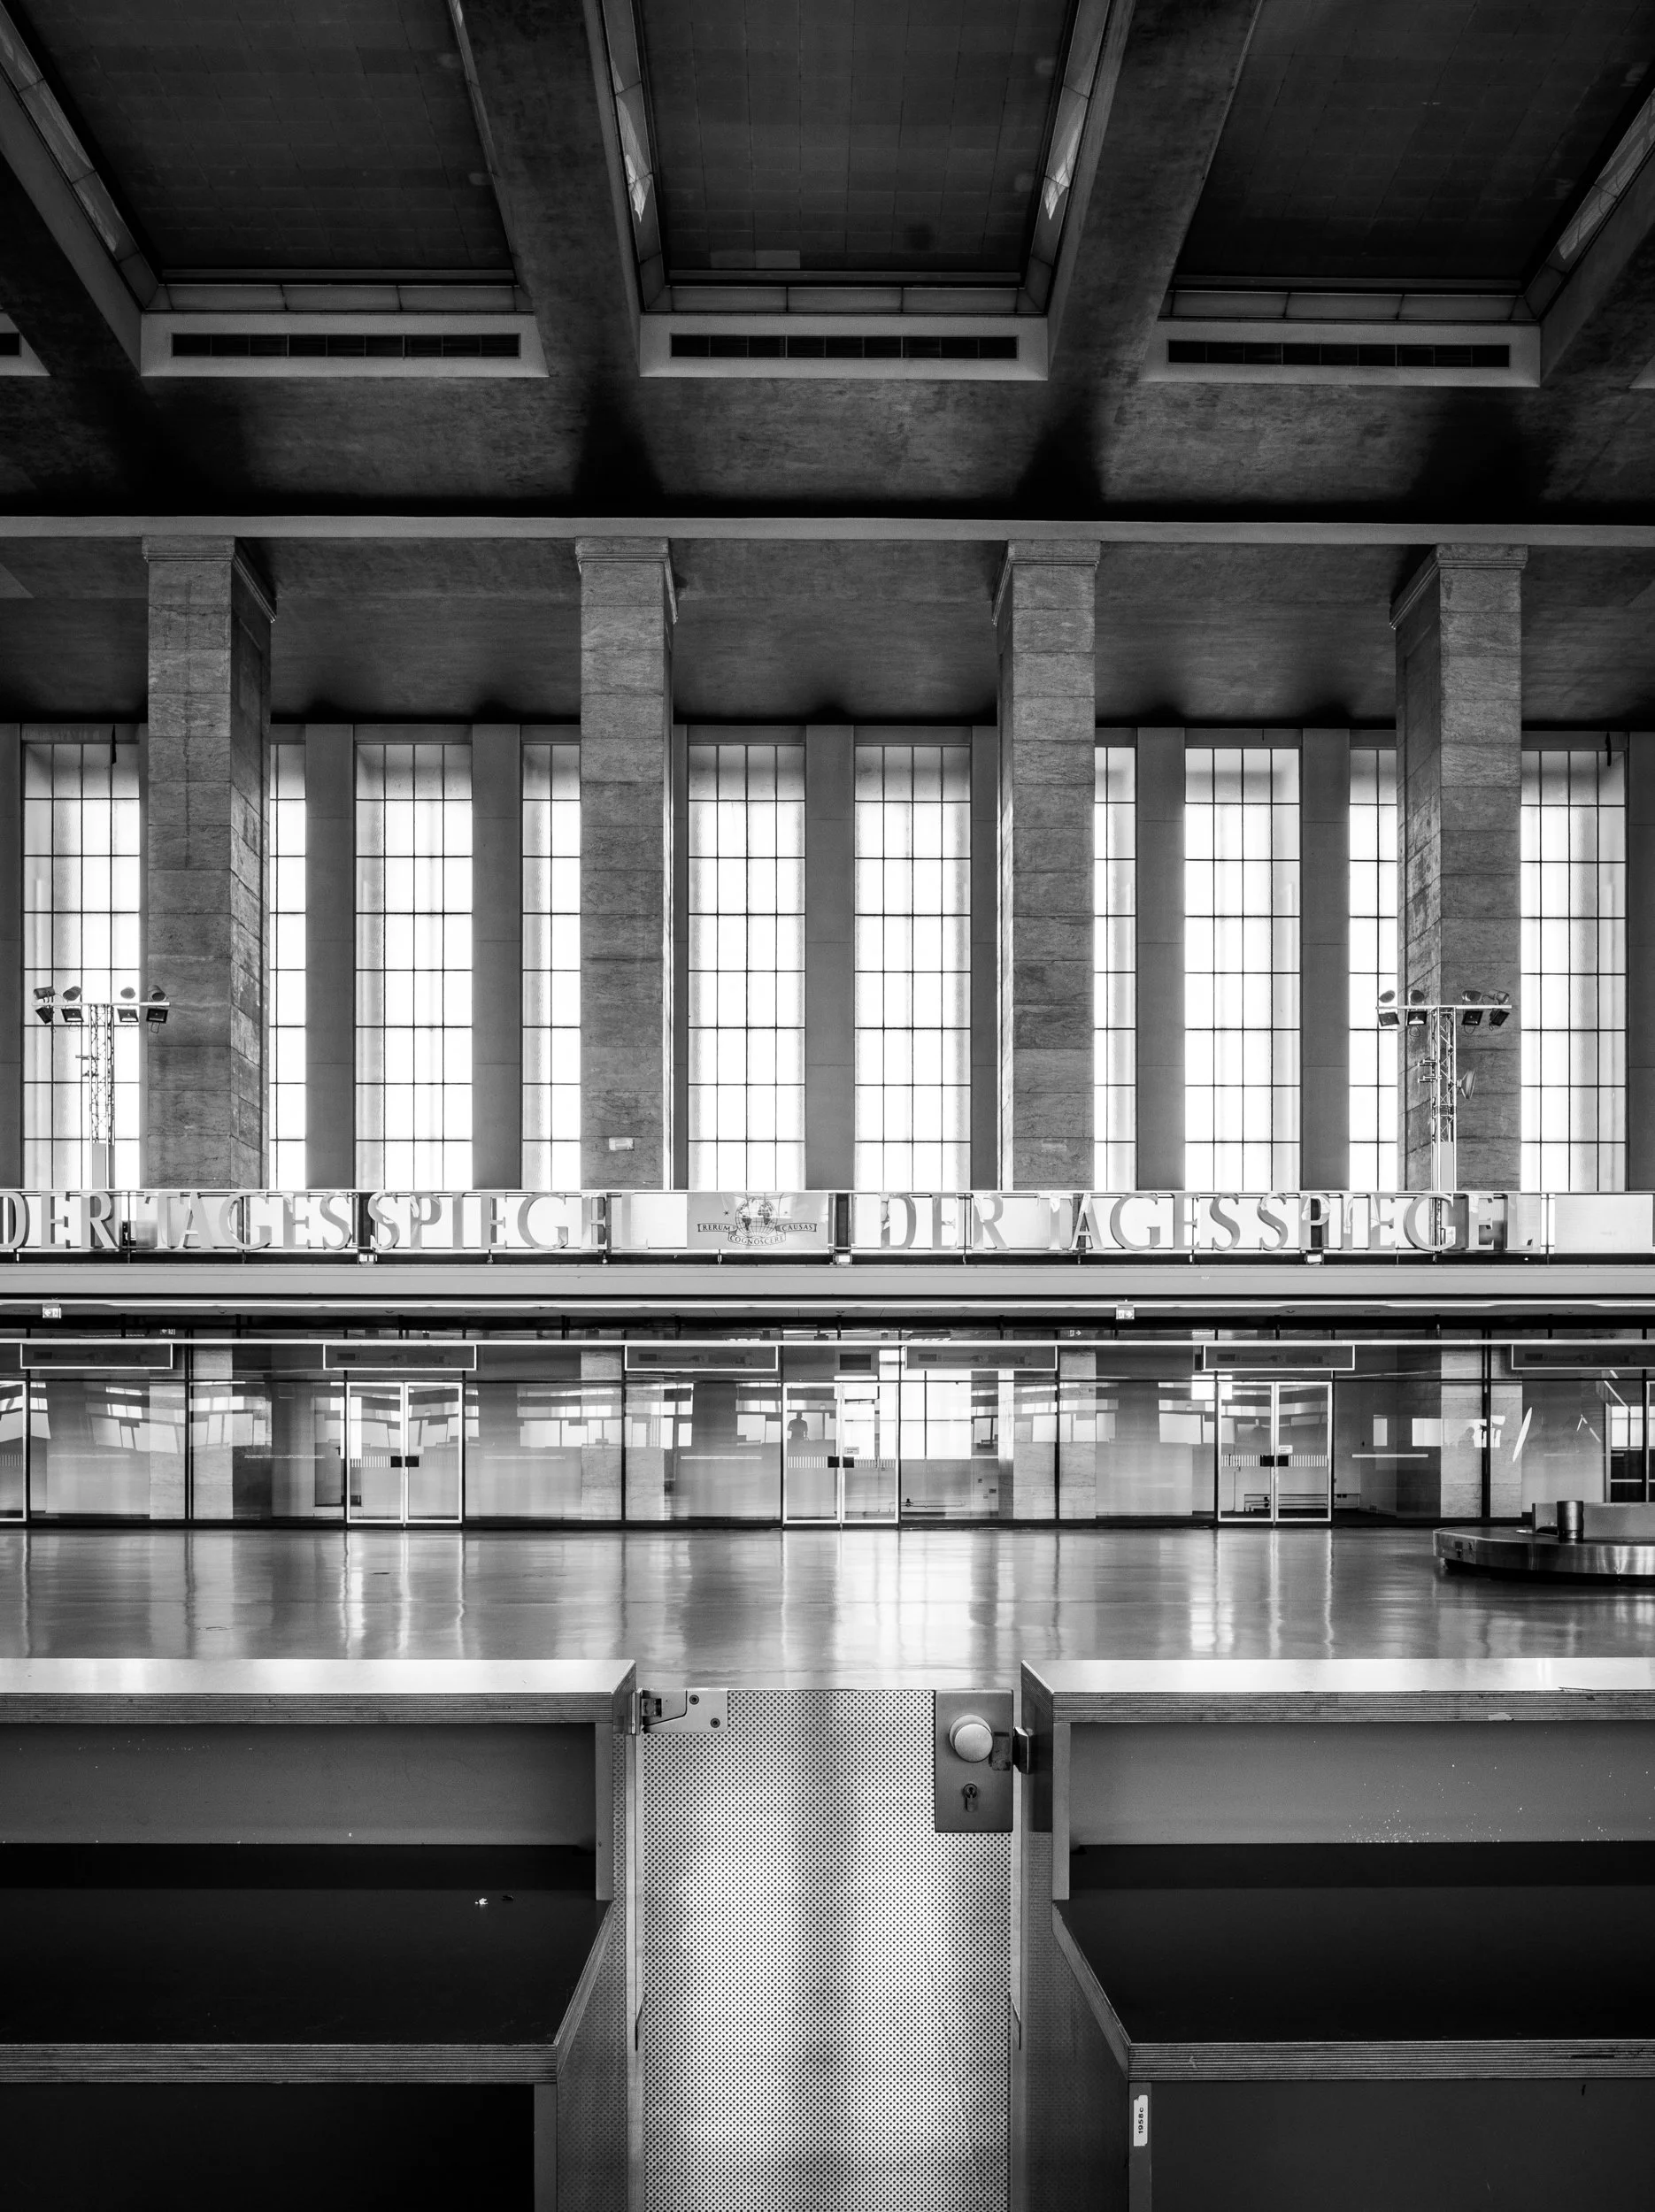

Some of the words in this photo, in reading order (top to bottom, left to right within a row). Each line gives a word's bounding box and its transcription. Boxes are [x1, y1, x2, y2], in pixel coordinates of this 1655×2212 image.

[0, 1191, 119, 1250] DER
[729, 1233, 784, 1245] COGNOSCERE
[781, 1223, 812, 1232] CAUSAS
[880, 1192, 1010, 1251] DER
[1037, 1192, 1534, 1252] TAGESSPIEGEL
